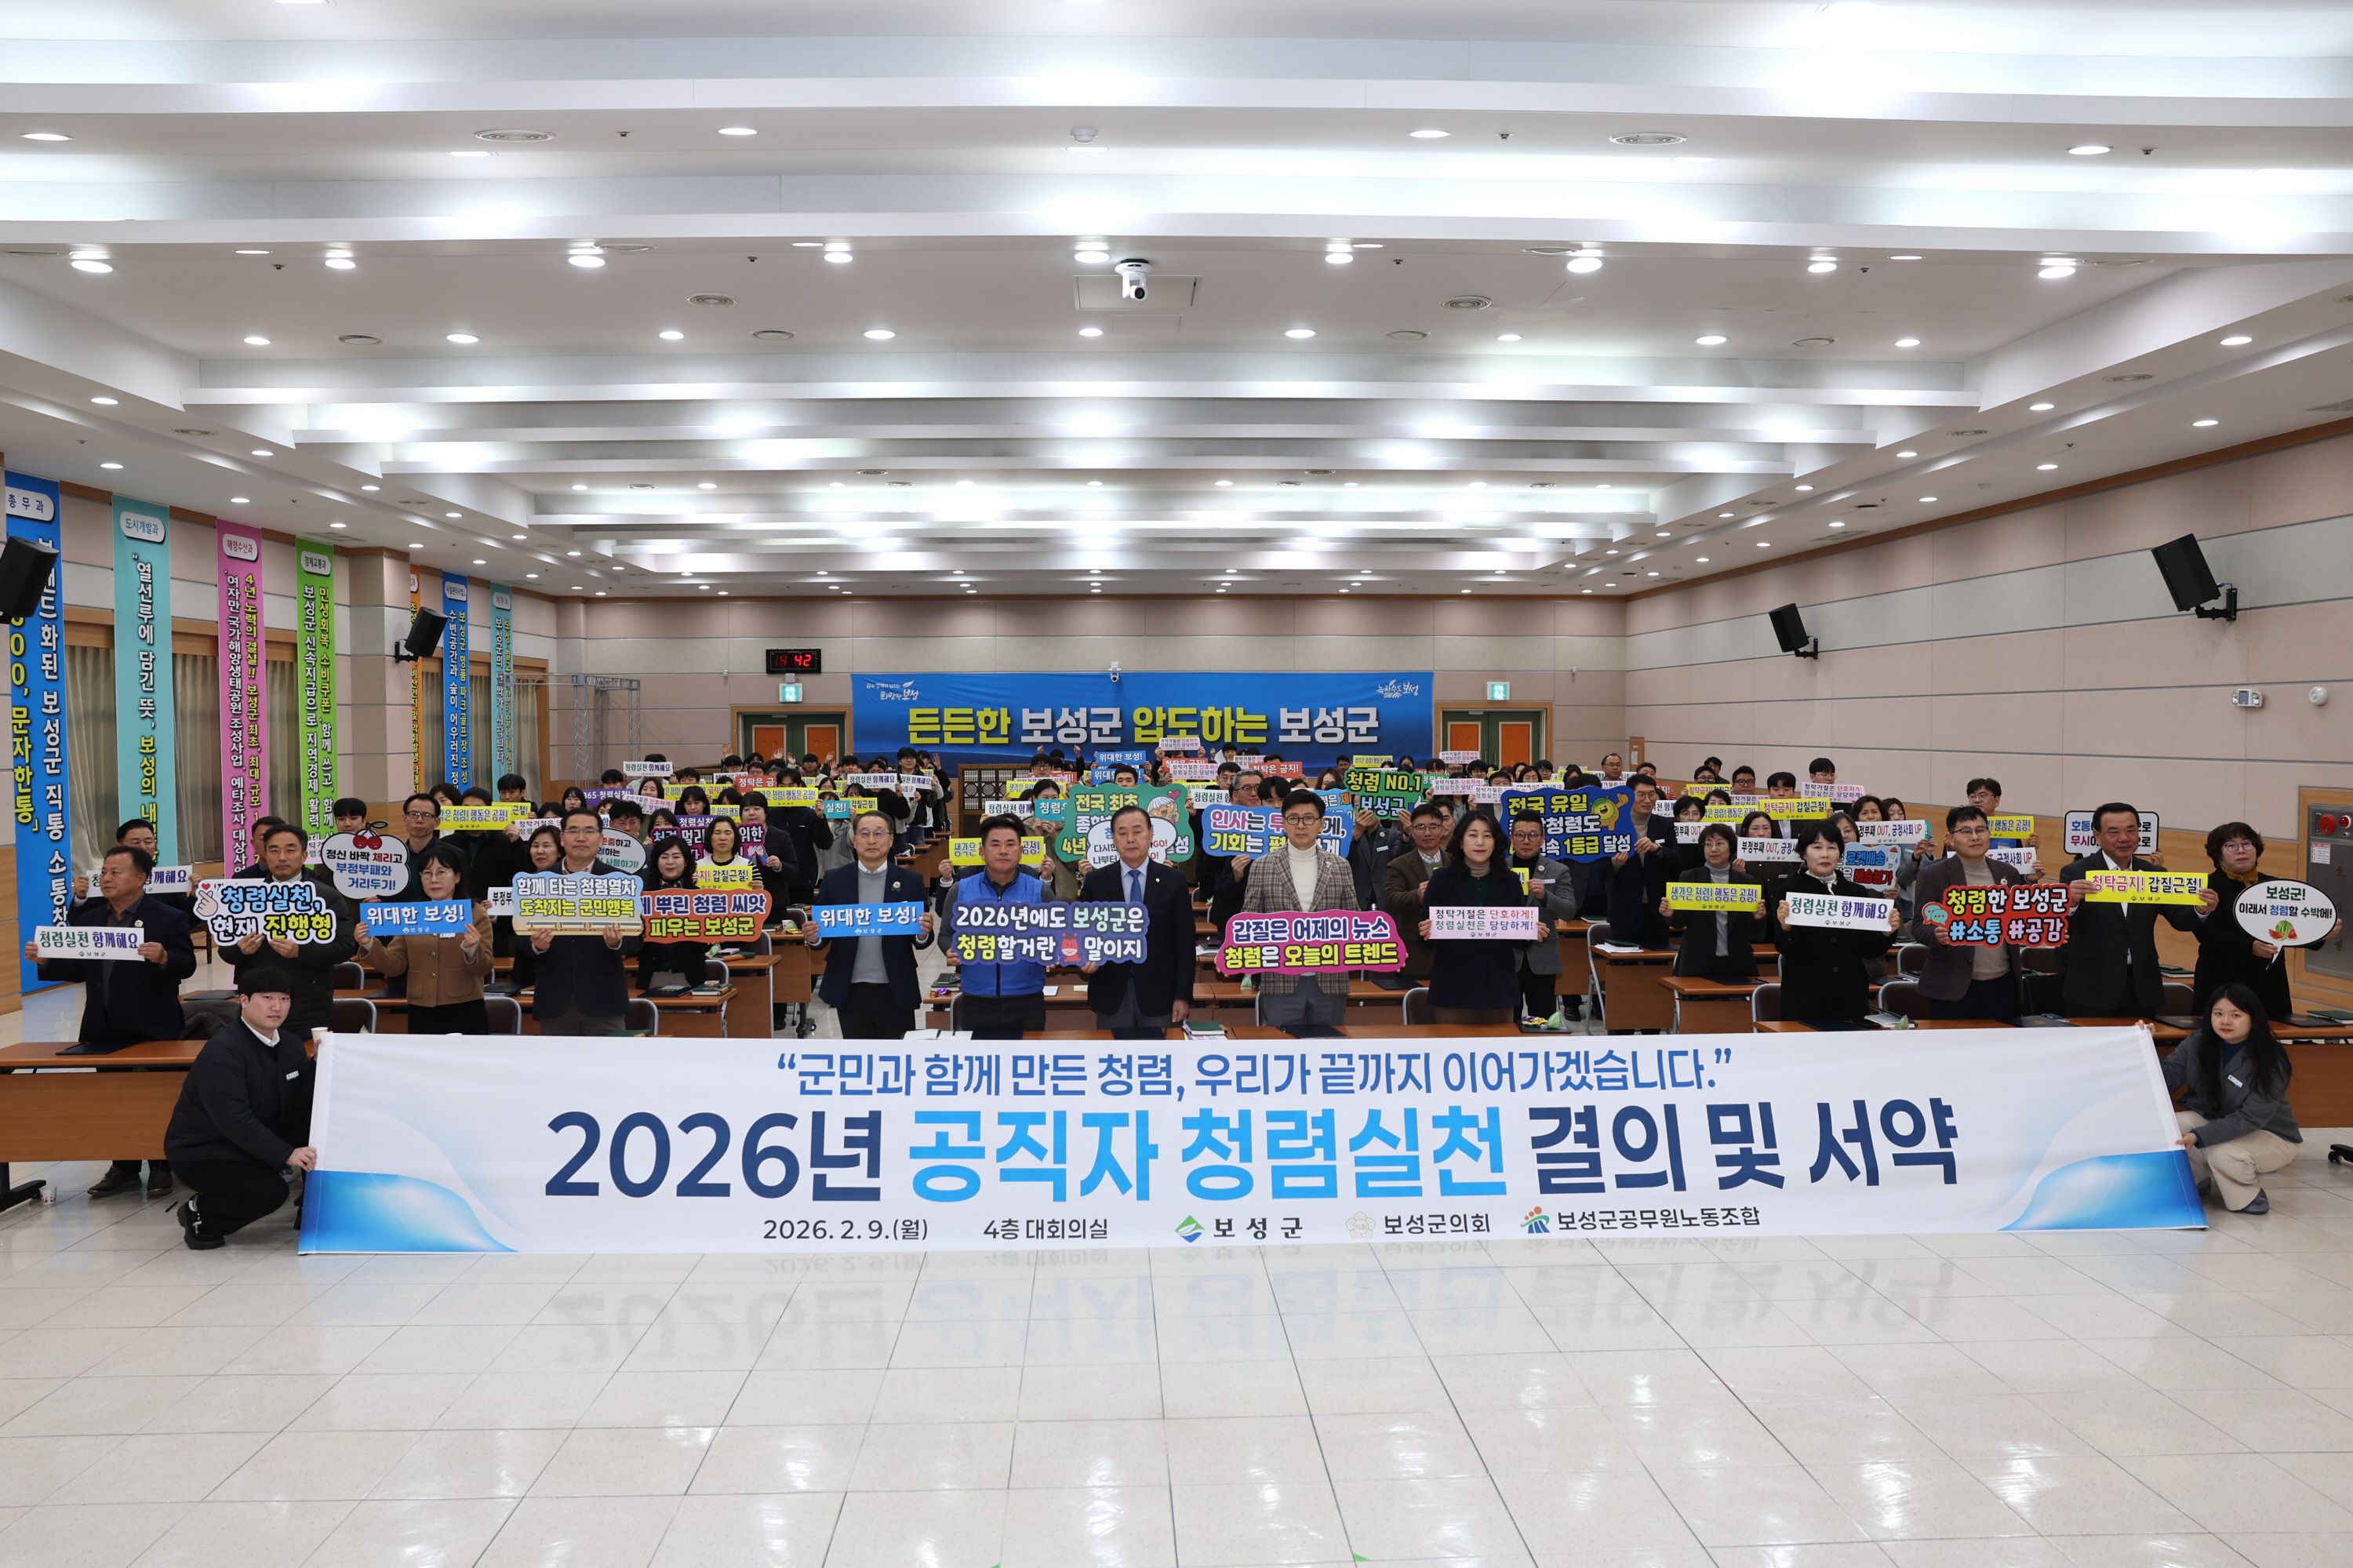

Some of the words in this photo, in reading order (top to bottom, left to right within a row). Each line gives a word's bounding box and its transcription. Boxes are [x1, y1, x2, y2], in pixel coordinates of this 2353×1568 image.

[125, 518, 159, 537] 도시개발과
[227, 539, 253, 555] 해양수산과
[244, 573, 257, 599] 4년
[303, 584, 317, 631] 보성군
[318, 587, 330, 649] 민생회복
[244, 601, 259, 639] 노력의
[227, 616, 243, 715] 국가해양생태공원
[245, 640, 259, 679] 결실!!
[795, 654, 813, 667] 42
[138, 650, 155, 693] 담긴
[304, 635, 318, 726] 신속지급으로
[320, 652, 333, 713] 소비쿠폰
[246, 684, 260, 721] 보성군
[449, 682, 459, 709] 숲이
[42, 690, 62, 774] 보성군
[908, 708, 1010, 744] 든든한
[1020, 708, 1122, 744] 보성군
[1133, 707, 1267, 743] 압도하는
[1279, 707, 1379, 743] 보성군
[450, 712, 460, 769] 어우러진
[140, 736, 157, 797] 보성의
[307, 732, 320, 795] 지역경제
[1100, 753, 1122, 762] 위대한
[1125, 751, 1143, 761] 보성!
[249, 756, 260, 781] 최대
[461, 756, 468, 784] 조성
[1280, 764, 1299, 774] 금지!
[739, 778, 764, 788] 청탁은
[1347, 771, 1380, 793] 청렴
[1385, 773, 1421, 792] NO.1
[231, 776, 247, 827] 예타조사
[249, 784, 262, 808] 규모
[1075, 793, 1105, 813] 전국
[1195, 791, 1223, 803] 청렴실천
[1361, 796, 1406, 817] 보성군
[1507, 796, 1545, 815] 전국
[1550, 794, 1588, 813] 유일
[45, 784, 66, 841] 직통
[308, 798, 322, 830] 활력
[323, 798, 335, 830] 함께
[471, 809, 491, 822] 행동은
[492, 809, 509, 822] 공정!
[826, 802, 848, 815] 실천!
[988, 803, 1017, 814] 청렴실천
[1764, 802, 1795, 815] 청탁금지!
[1796, 802, 1827, 813] 갑질근절!
[1211, 809, 1265, 832] 인사는
[1915, 824, 1922, 835] UP
[1994, 819, 2013, 831] 행동은
[2015, 819, 2031, 831] 공정!
[954, 842, 976, 857] 생각은
[1022, 840, 1040, 855] 공정!
[1063, 835, 1086, 857] 4년
[1209, 832, 1264, 855] 기회는
[1563, 836, 1599, 855] 1등급
[1602, 835, 1631, 853] 달성
[1741, 841, 1765, 855] 부정부패
[325, 849, 347, 860] 정신
[349, 851, 370, 862] 바짝
[372, 852, 403, 864] 체리고
[1846, 850, 1886, 867] 로켓배송
[2023, 851, 2033, 864] UP
[336, 862, 393, 877] 부정부패와
[711, 869, 748, 883] 갑질근절!
[1853, 868, 1893, 886] 배송불가
[347, 877, 396, 891] 거리두기!
[516, 878, 545, 897] 함께
[548, 878, 577, 897] 타는
[580, 877, 637, 897] 청렴열차
[1671, 886, 1693, 902] 생각은
[1695, 886, 1713, 902] 청렴!
[1715, 887, 1737, 903] 행동은
[1739, 888, 1758, 904] 공정!
[2093, 875, 2146, 894] 청탁금지!
[2148, 875, 2203, 896] 갑질근절!
[2266, 886, 2306, 901] 보성군!
[221, 885, 322, 914] 청렴실천,
[519, 898, 576, 917] 도착지는
[579, 899, 636, 918] 군민행복
[654, 894, 690, 915] 뿌린
[693, 894, 729, 915] 청렴
[730, 893, 767, 915] 씨앗
[1791, 897, 1838, 917] 청렴실천
[1840, 900, 1889, 920] 함께해요
[1947, 889, 2008, 915] 청렴한
[2012, 889, 2068, 914] 보성군
[366, 906, 419, 926] 위대한
[424, 904, 466, 923] 보성!
[820, 908, 872, 928] 위대한
[876, 906, 918, 925] 보성!
[955, 905, 1067, 931] 2026년에도
[1071, 906, 1144, 933] 보성군은
[1435, 909, 1486, 920] 청탁거절은
[1489, 909, 1534, 920] 단호하게!
[2238, 903, 2268, 915] 이래서
[2269, 904, 2299, 917] 청렴할
[2300, 907, 2333, 919] 수박에!
[211, 915, 259, 942] 현재
[264, 912, 333, 940] 진행형
[649, 917, 701, 937] 피우는
[704, 915, 755, 936] 보성군
[1233, 919, 1289, 942] 갑질은
[1293, 917, 1347, 940] 어제의
[1354, 917, 1389, 940] 뉴스
[1435, 920, 1486, 931] 청렴실천은
[1489, 920, 1534, 932] 당당하게!
[1949, 919, 2002, 944] #소통
[2008, 918, 2064, 943] #공감
[39, 930, 90, 948] 청렴실천
[91, 931, 140, 949] 함께해요
[956, 933, 1056, 962] 청렴할거란
[1083, 936, 1141, 962] 말이지
[1224, 945, 1280, 969] 청렴은
[1284, 944, 1340, 967] 오늘의
[1344, 942, 1399, 965] 트렌드
[777, 1053, 917, 1097] “군민과
[923, 1053, 1002, 1097] 함께
[1012, 1053, 1088, 1097] 만든
[1097, 1053, 1185, 1101] 청렴,
[1195, 1052, 1311, 1097] 우리가
[1318, 1051, 1432, 1097] 끝까지
[1442, 1047, 1732, 1094] 이어가겠습니다.”
[544, 1109, 882, 1202] 2026년
[909, 1108, 1159, 1203] 공직자
[1177, 1106, 1507, 1202] 청렴실천
[1528, 1102, 1688, 1196] 결의
[1705, 1101, 1786, 1191] 및
[1809, 1097, 1959, 1188] 서약
[983, 1217, 1018, 1240] 4층
[1023, 1217, 1108, 1241] 대회의실
[1384, 1213, 1491, 1235] 보성군의회
[1557, 1206, 1761, 1233] 보성군공무원노동조합
